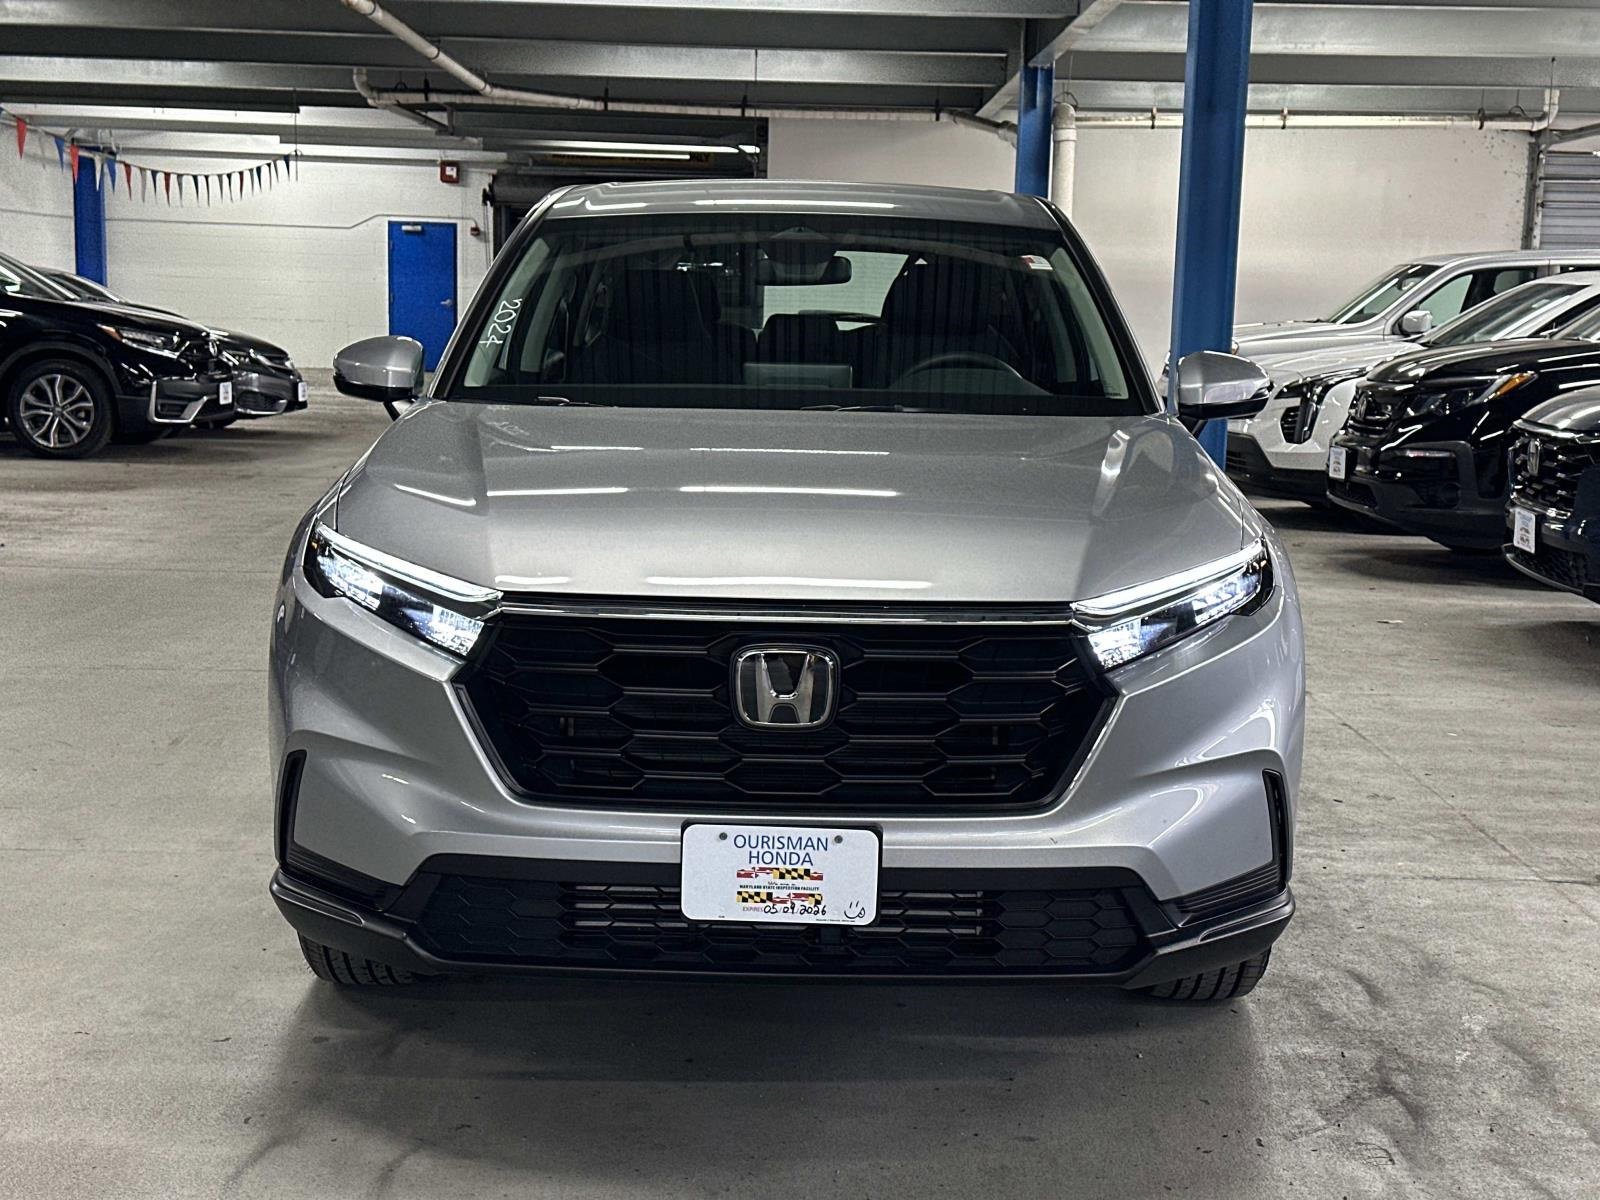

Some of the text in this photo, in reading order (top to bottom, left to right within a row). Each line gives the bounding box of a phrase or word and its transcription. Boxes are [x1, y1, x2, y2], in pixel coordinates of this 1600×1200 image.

[479, 298, 523, 348] 2024
[733, 834, 829, 851] OURISMAN
[748, 850, 814, 866] HONDA
